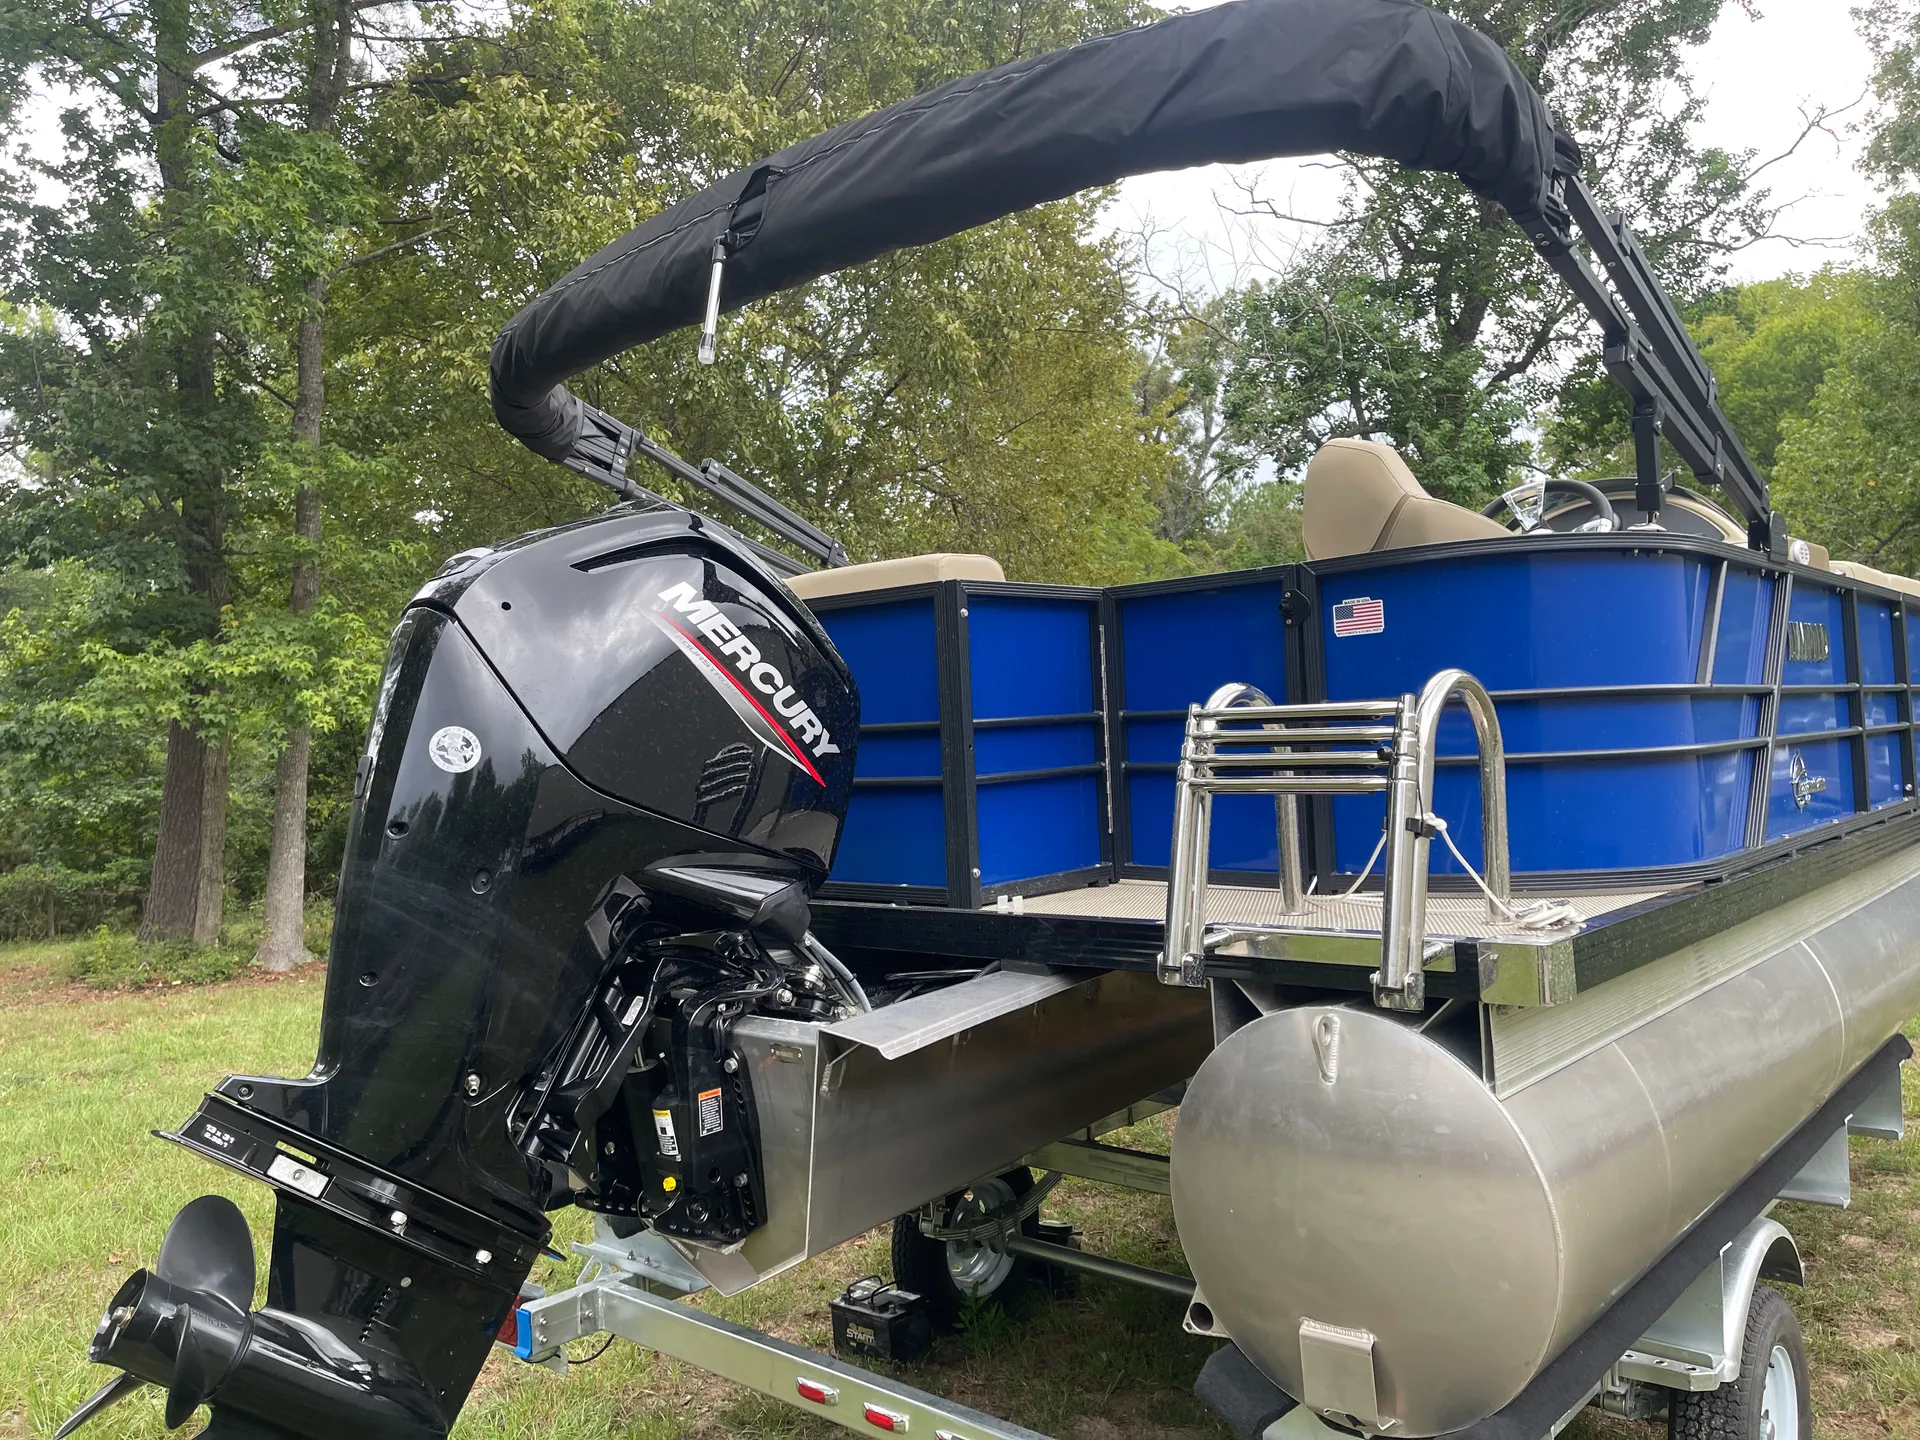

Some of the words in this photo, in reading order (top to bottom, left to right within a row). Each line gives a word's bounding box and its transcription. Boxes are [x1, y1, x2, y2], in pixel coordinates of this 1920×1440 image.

[658, 581, 841, 758] MERCURY
[675, 633, 742, 698] FOURSTROKE
[846, 1328, 874, 1343] START
